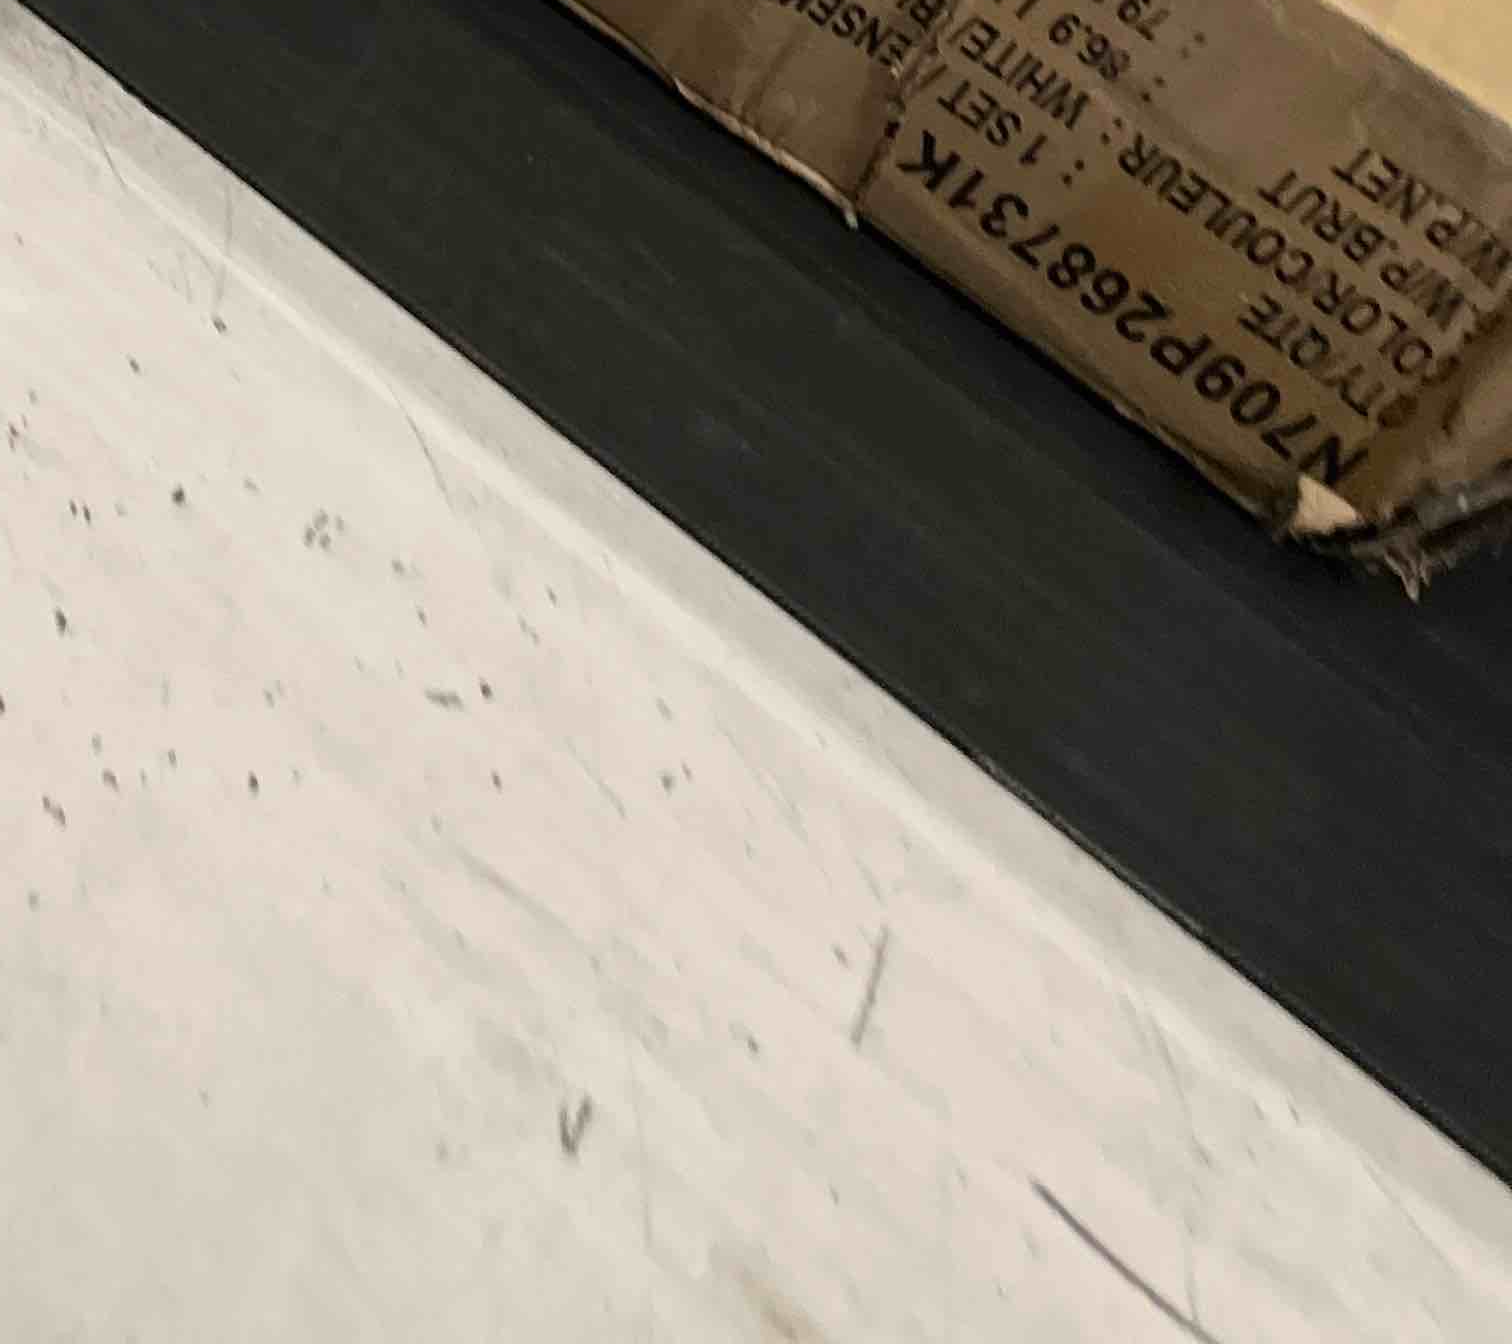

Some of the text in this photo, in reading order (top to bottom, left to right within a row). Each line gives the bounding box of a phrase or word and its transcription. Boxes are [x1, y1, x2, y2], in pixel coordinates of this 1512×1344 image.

[1045, 12, 1133, 84] 86.9
[934, 77, 1025, 150] SET
[893, 125, 1375, 493] N709P268731K
